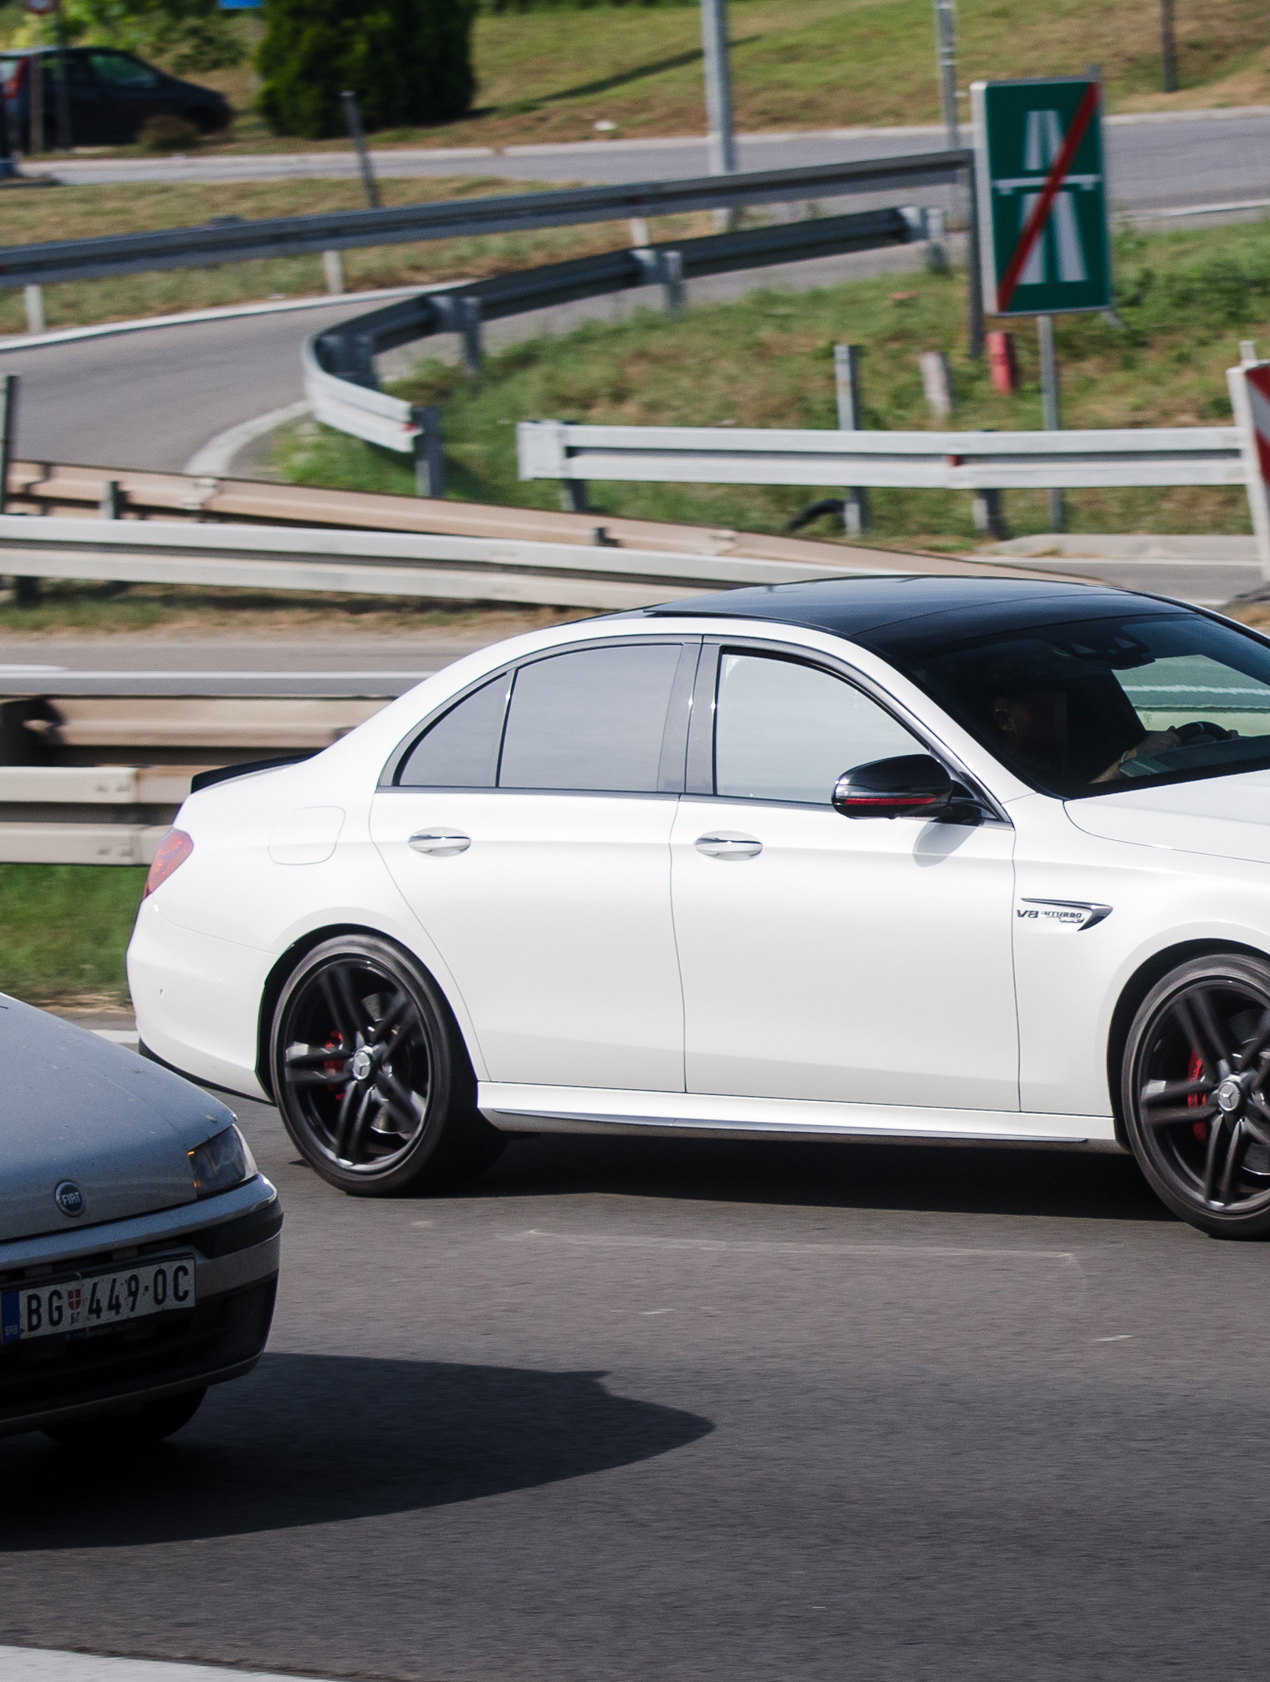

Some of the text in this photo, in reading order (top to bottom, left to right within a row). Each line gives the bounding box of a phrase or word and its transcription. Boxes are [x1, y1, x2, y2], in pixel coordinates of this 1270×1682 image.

[1017, 909, 1039, 918] V8
[61, 1192, 81, 1206] FIAT
[27, 1289, 63, 1332] BG
